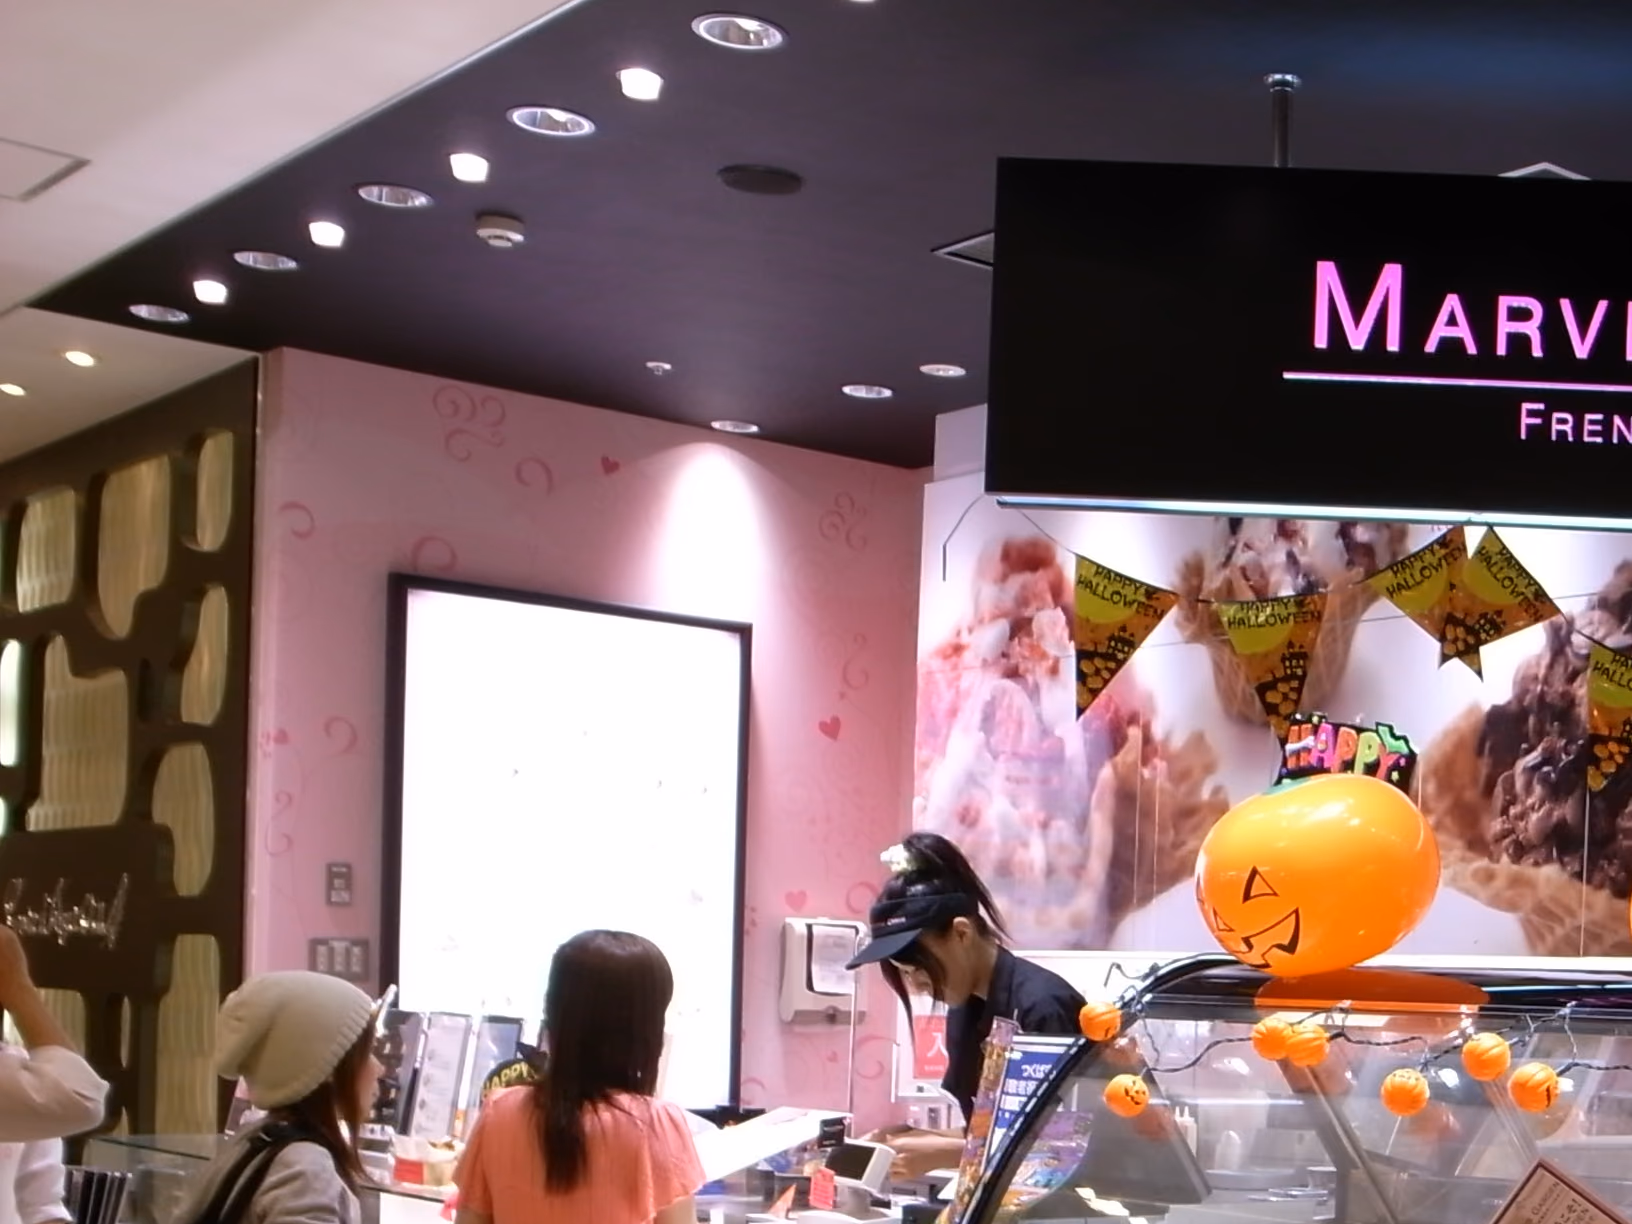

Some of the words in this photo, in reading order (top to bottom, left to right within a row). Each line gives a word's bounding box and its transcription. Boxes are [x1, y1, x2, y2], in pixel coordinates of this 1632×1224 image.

[1094, 564, 1143, 596] HAPPY
[1076, 573, 1165, 620] HALLOWEEN
[1239, 598, 1292, 613] HAPPY
[1227, 610, 1322, 629] HALLOWEEN
[1286, 722, 1411, 781] HAPPY
